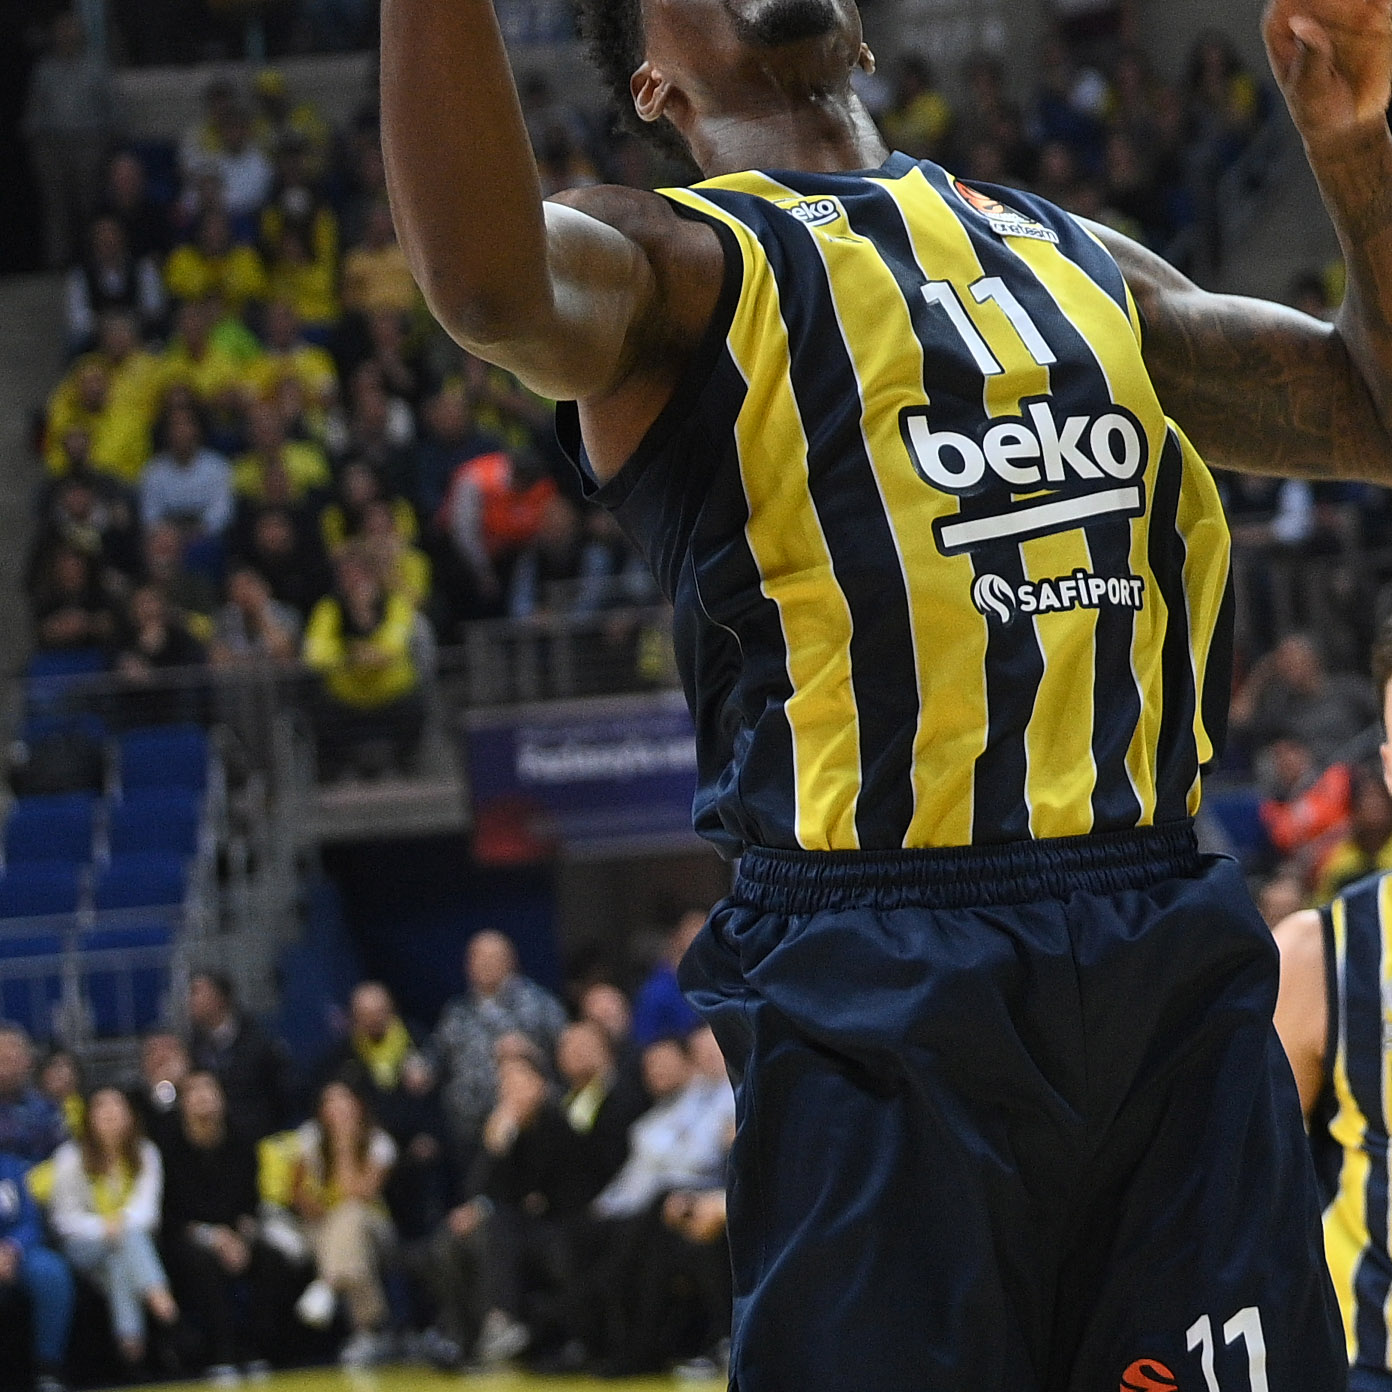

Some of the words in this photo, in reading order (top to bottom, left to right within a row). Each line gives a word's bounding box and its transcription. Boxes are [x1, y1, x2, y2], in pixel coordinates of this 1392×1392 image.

[787, 200, 834, 220] eko
[920, 276, 1056, 375] 11
[907, 402, 1141, 488] beko
[1186, 1306, 1269, 1392] 11
